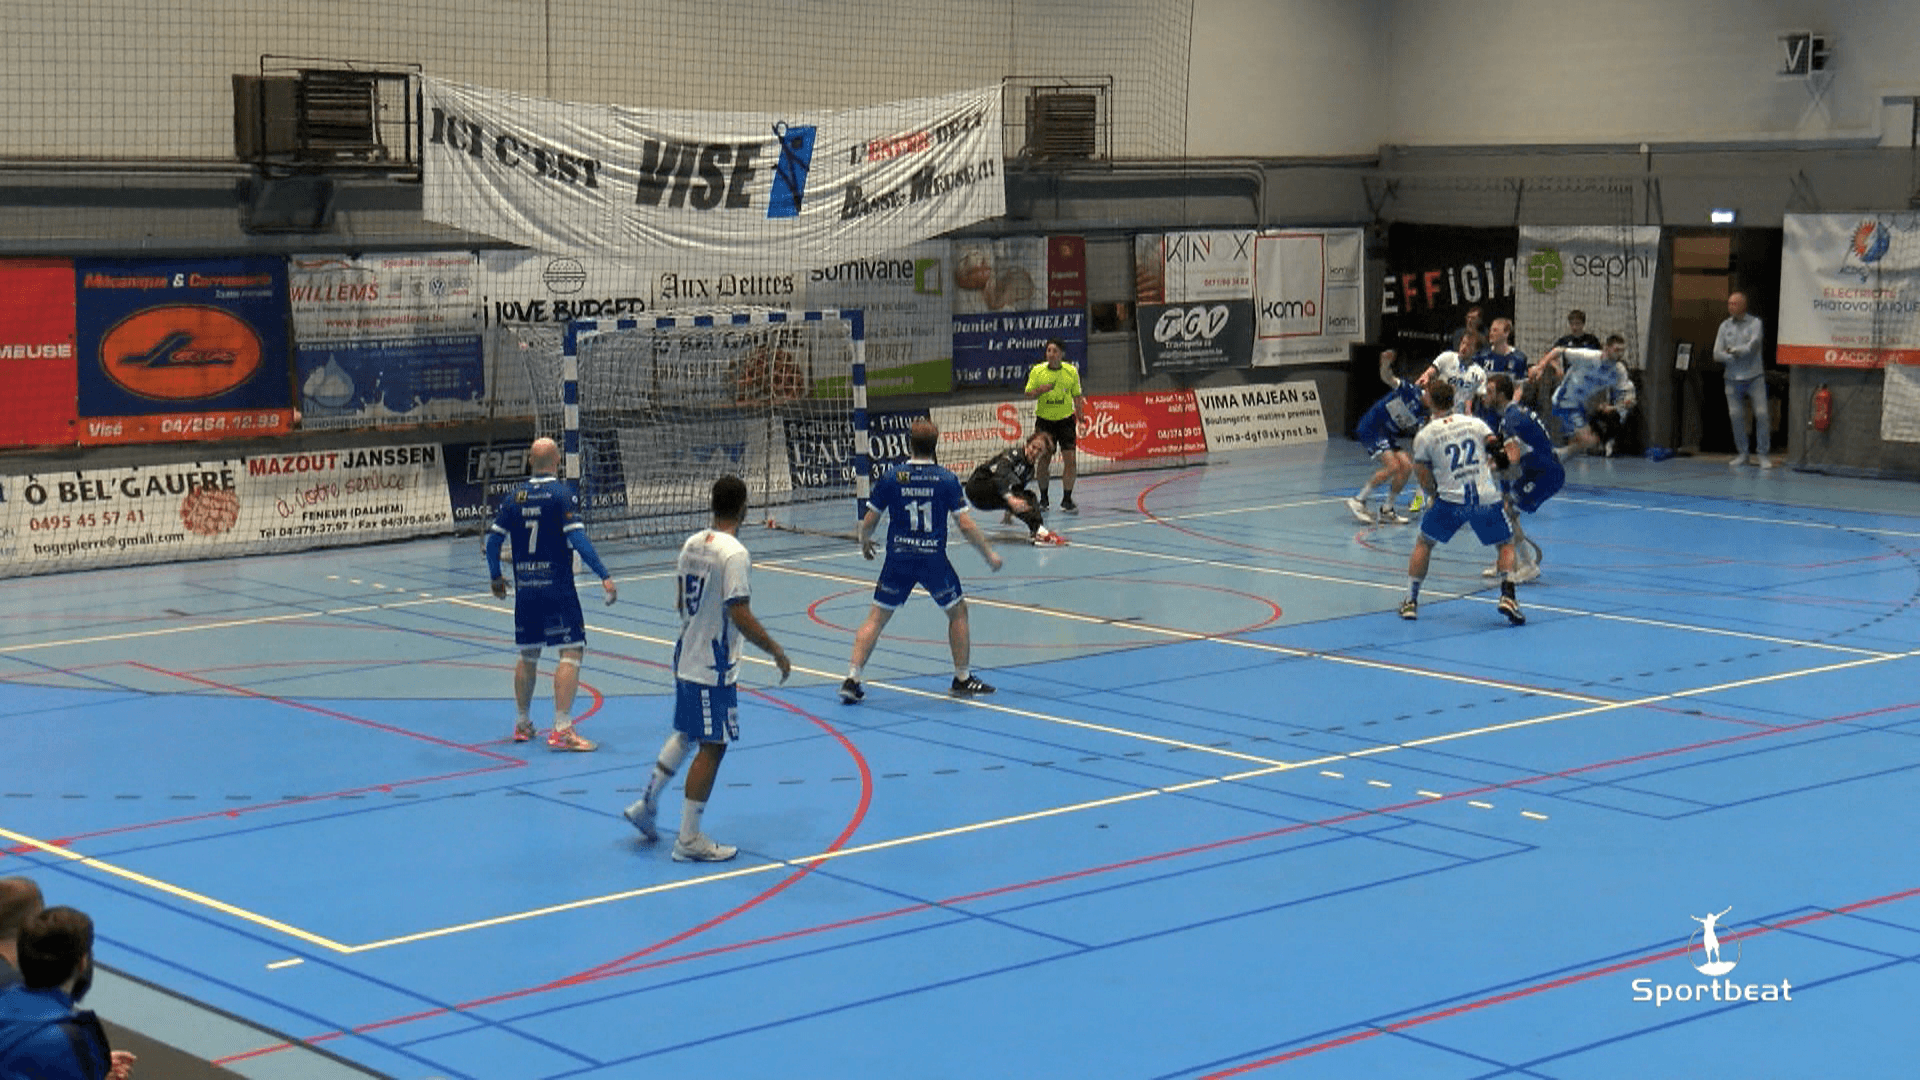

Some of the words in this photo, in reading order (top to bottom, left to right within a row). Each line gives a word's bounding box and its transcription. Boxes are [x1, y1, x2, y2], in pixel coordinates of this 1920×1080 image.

[430, 107, 483, 158] ICI
[496, 135, 602, 188] C'EST
[636, 140, 764, 210] VISE
[172, 272, 185, 287] &
[290, 283, 379, 302] WILLEMS
[1002, 313, 1084, 332] WATHELET
[988, 338, 1005, 351] Le
[1201, 393, 1239, 410] VIMA
[1242, 389, 1298, 407] MAJEAN
[1302, 389, 1317, 402] sa
[89, 421, 123, 437] Visé
[250, 453, 339, 477] MAZOUT
[344, 446, 435, 469] JANSSEN
[1444, 438, 1480, 472] 22
[30, 514, 71, 531] 0495
[77, 513, 97, 527] 45
[102, 511, 120, 525] 57
[126, 509, 145, 523] 41
[302, 507, 348, 521] FENEUR
[350, 504, 404, 518] (DALHEM)
[904, 500, 933, 533] 11
[358, 519, 378, 530] Fax
[525, 520, 540, 555] 7
